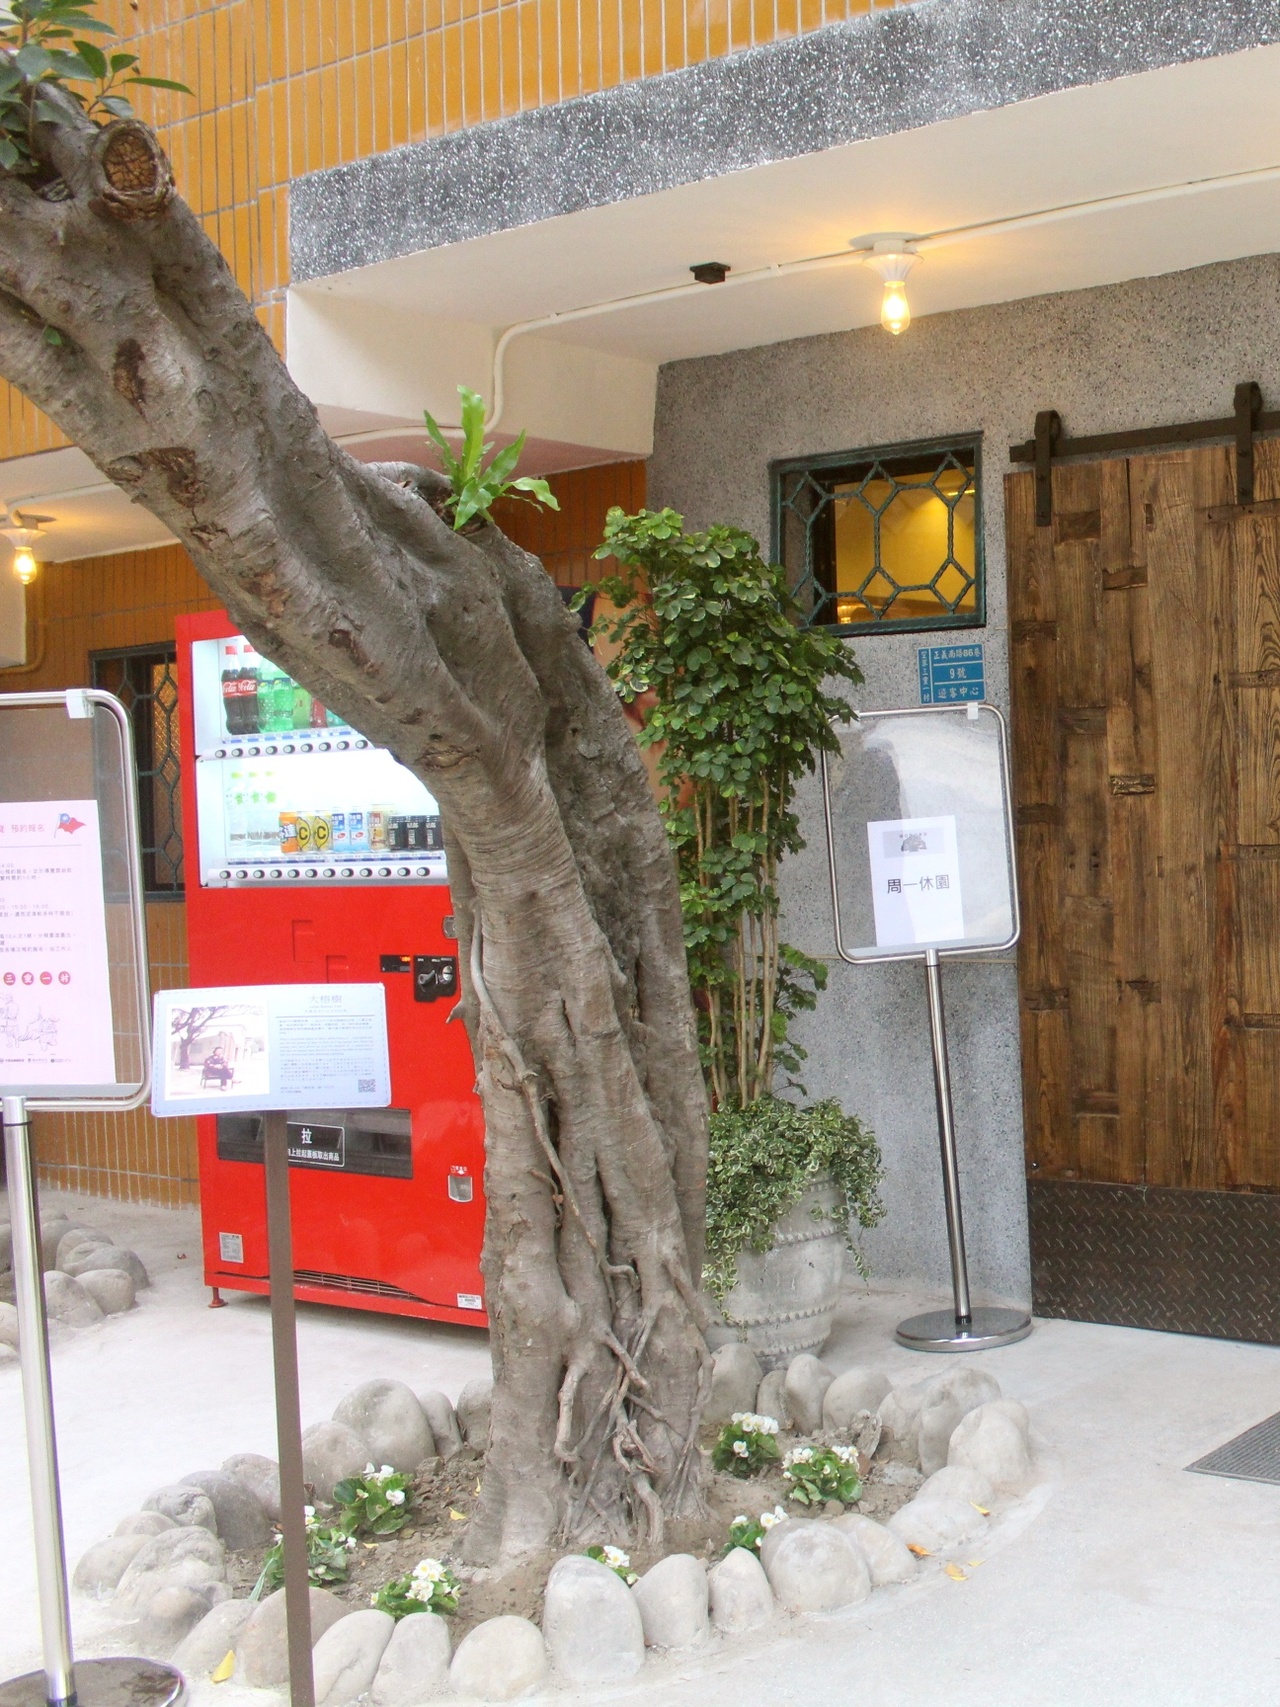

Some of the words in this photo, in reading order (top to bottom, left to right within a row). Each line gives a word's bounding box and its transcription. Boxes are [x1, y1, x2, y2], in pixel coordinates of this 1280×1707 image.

[933, 647, 981, 660] 正義南路86巷
[949, 667, 967, 679] 9號
[938, 686, 979, 699] 遊客中心
[887, 874, 950, 894] 周一休園
[301, 1127, 313, 1144] 拉
